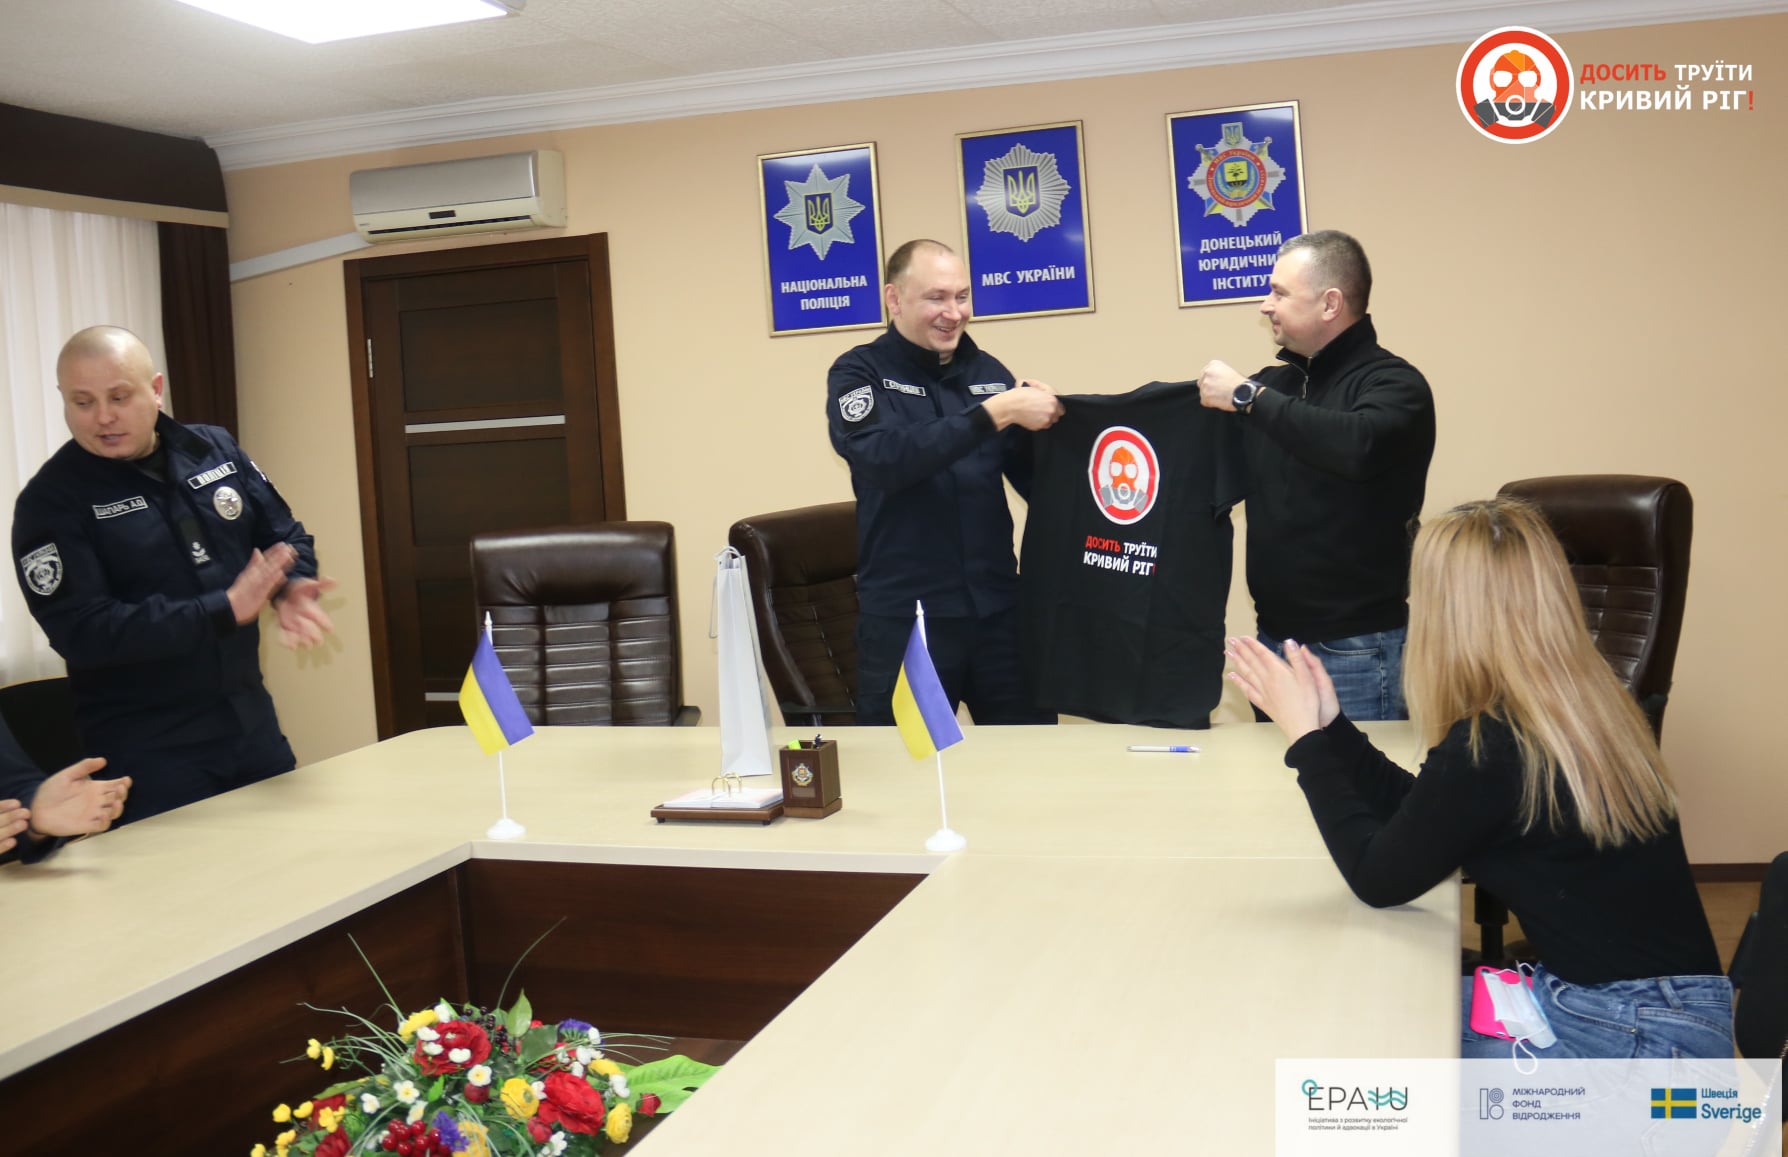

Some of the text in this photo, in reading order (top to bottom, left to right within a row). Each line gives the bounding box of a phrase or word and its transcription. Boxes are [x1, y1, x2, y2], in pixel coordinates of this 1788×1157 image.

[1200, 230, 1282, 254] ДОНЕЦЬКИЙ
[1198, 253, 1277, 272] ЮРИДИЧНИ
[781, 275, 868, 294] НАЦІОНАЛЬНА
[982, 264, 1075, 286] МВС УКРАЇНИ
[801, 295, 850, 310] ПОЛІЦІЯ
[1085, 535, 1157, 558] ДОСИТЬ ТРУЇТИ
[1083, 551, 1129, 573] КРИВИЙ
